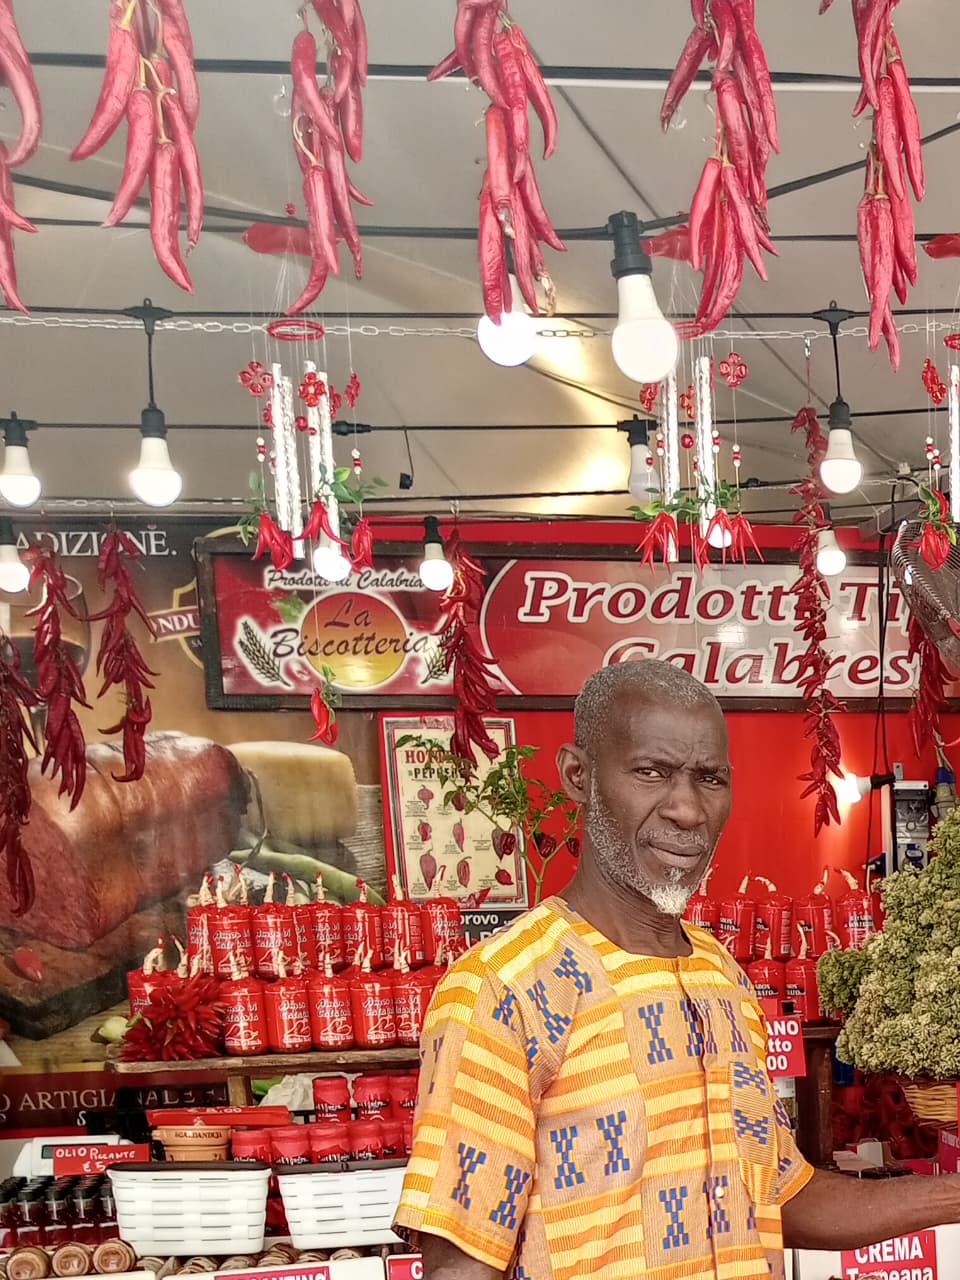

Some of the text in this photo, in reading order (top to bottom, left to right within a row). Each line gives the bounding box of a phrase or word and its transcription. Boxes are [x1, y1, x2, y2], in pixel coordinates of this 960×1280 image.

[357, 567, 425, 589] Calabria
[324, 598, 371, 628] La
[270, 627, 430, 658] Biscotteria
[56, 1147, 87, 1158] OLIO
[854, 1236, 924, 1264] CREMA
